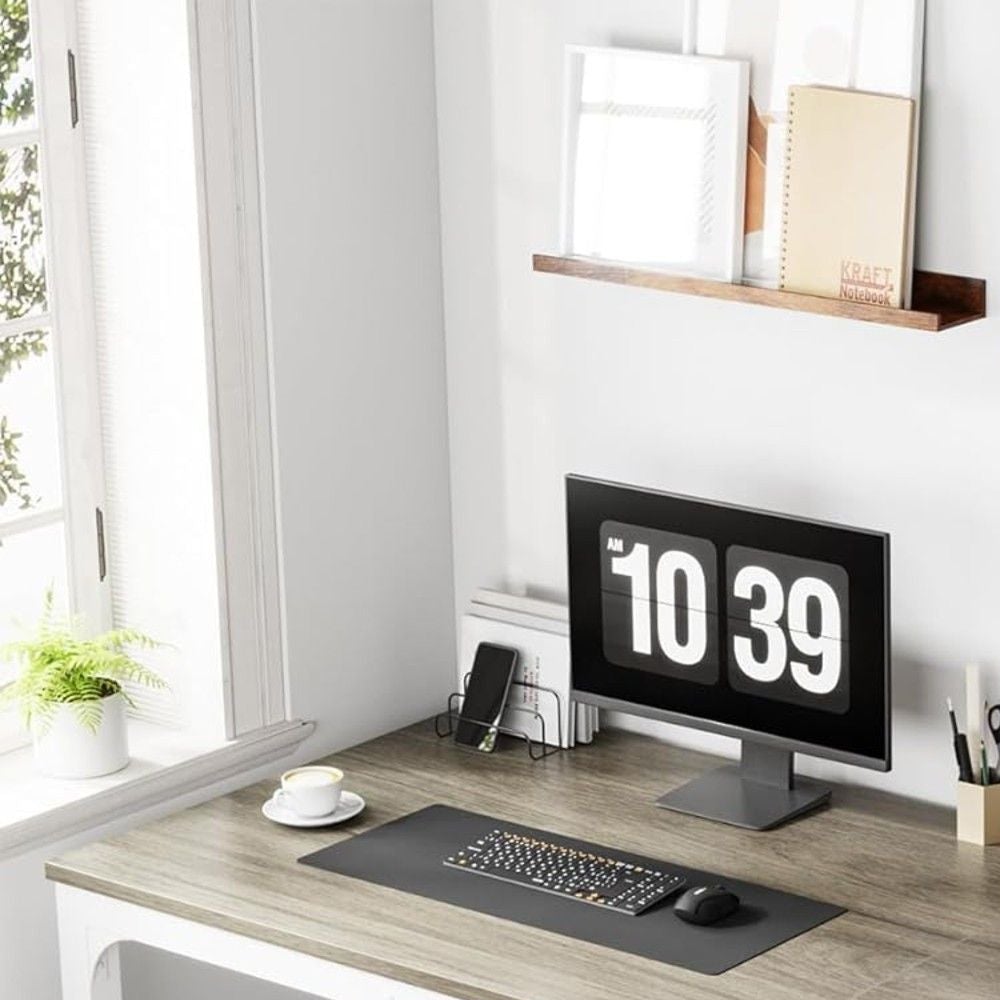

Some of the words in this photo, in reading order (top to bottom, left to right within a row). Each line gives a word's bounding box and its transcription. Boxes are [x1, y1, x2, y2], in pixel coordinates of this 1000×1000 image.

[841, 260, 893, 286] KRAFT
[840, 284, 890, 305] Notebook
[607, 537, 623, 553] AM
[611, 542, 707, 665] 10
[733, 565, 842, 694] 39
